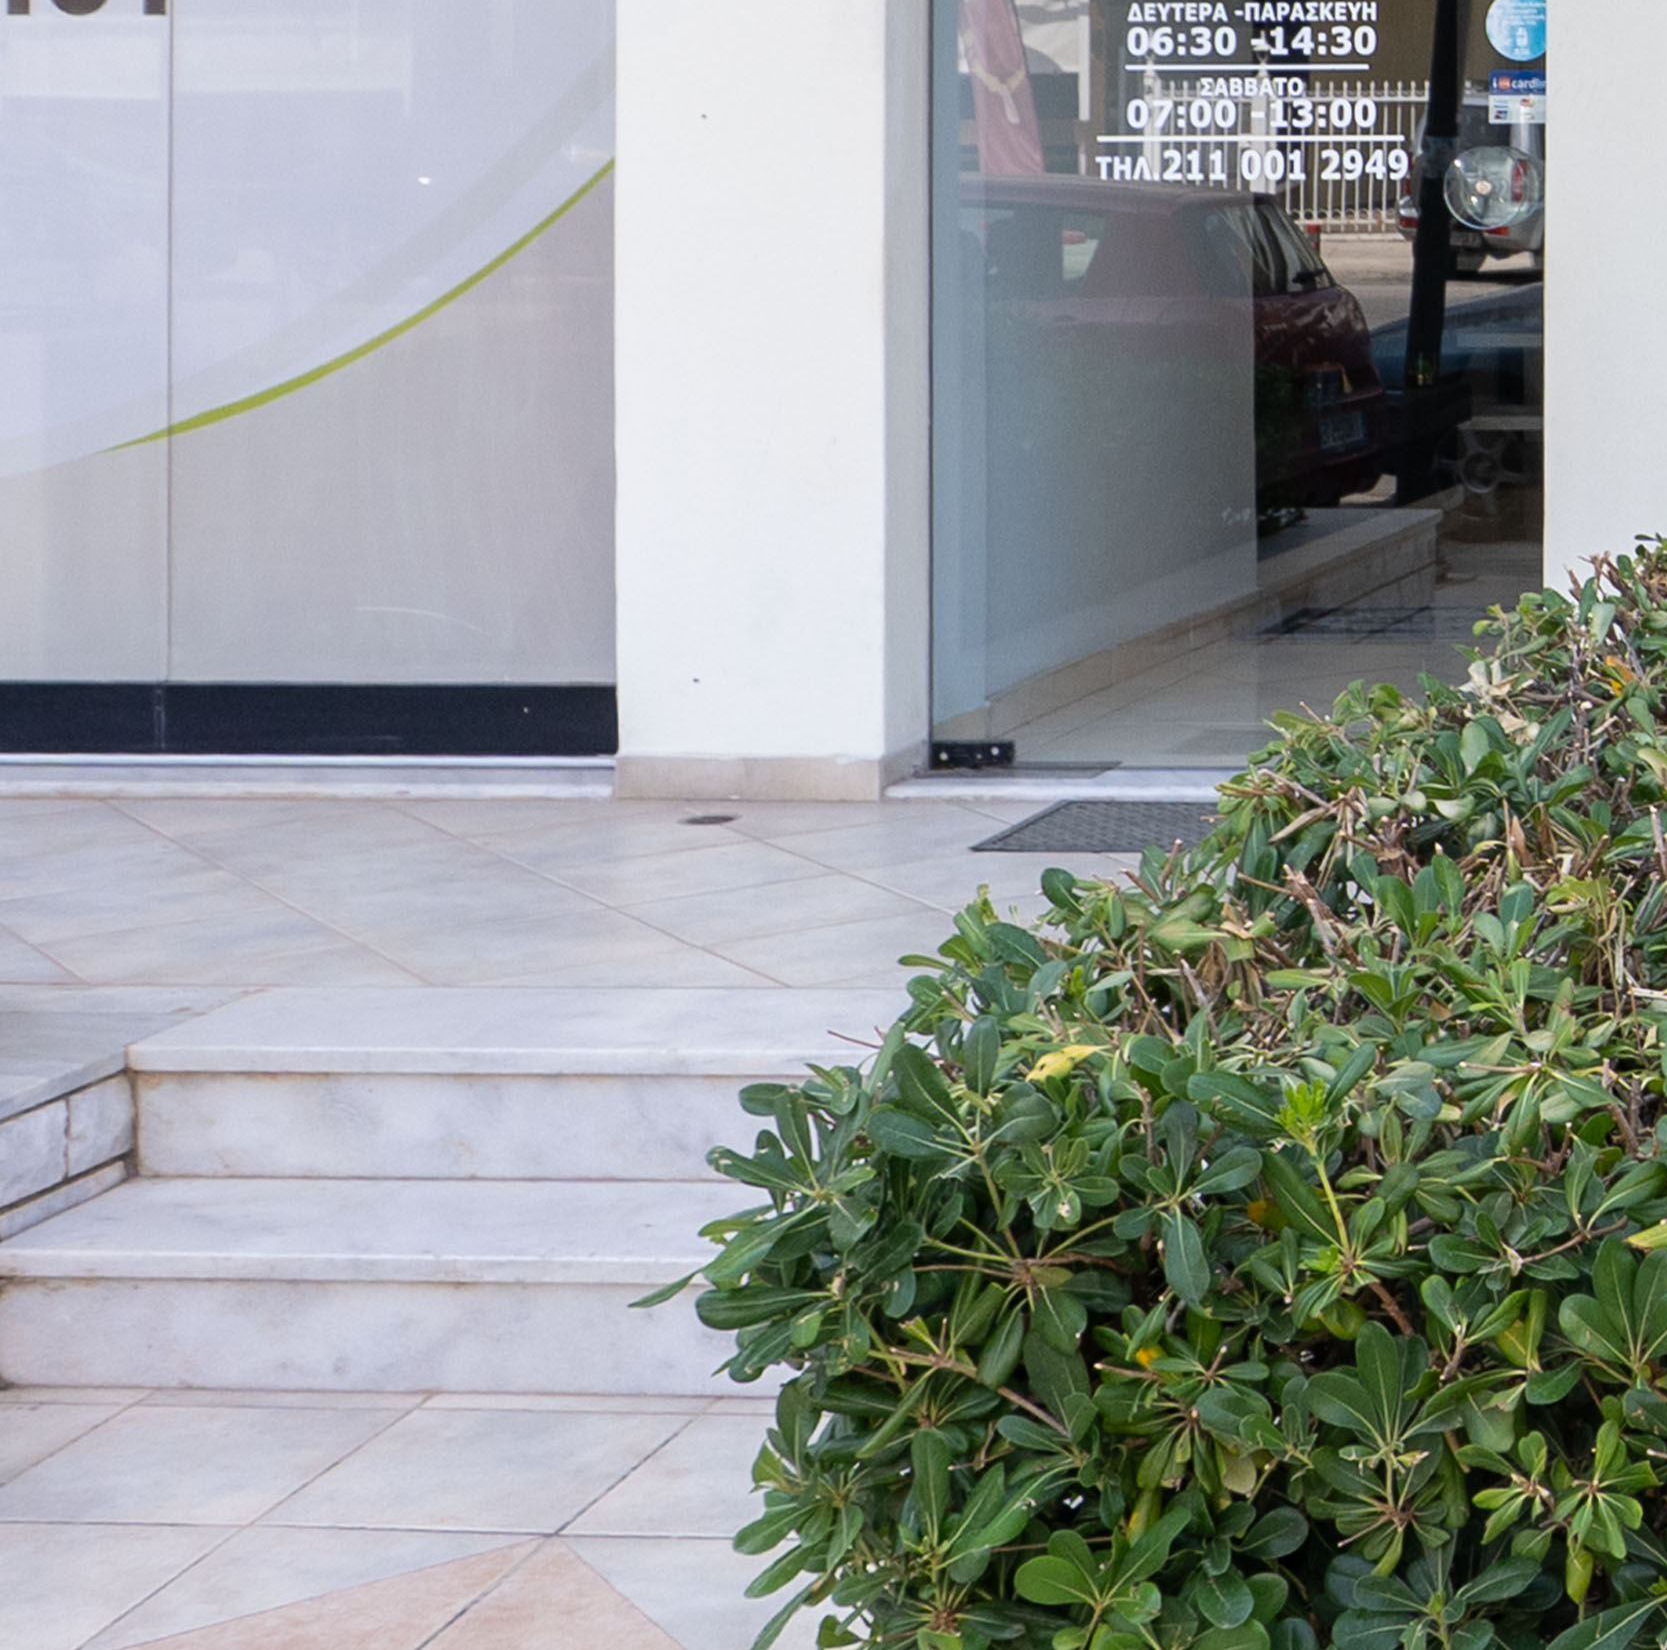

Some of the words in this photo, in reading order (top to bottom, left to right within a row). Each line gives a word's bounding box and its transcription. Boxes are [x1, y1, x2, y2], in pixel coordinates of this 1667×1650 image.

[1127, 3, 1228, 23] ΔΕΥΤΕΡΑ
[1126, 26, 1238, 57] 06:30
[1199, 76, 1304, 98] ΣΑΒΒΑΤΟ
[1126, 98, 1237, 129] 07:00
[1240, 149, 1306, 182] 001
[1320, 148, 1409, 181] 2949
